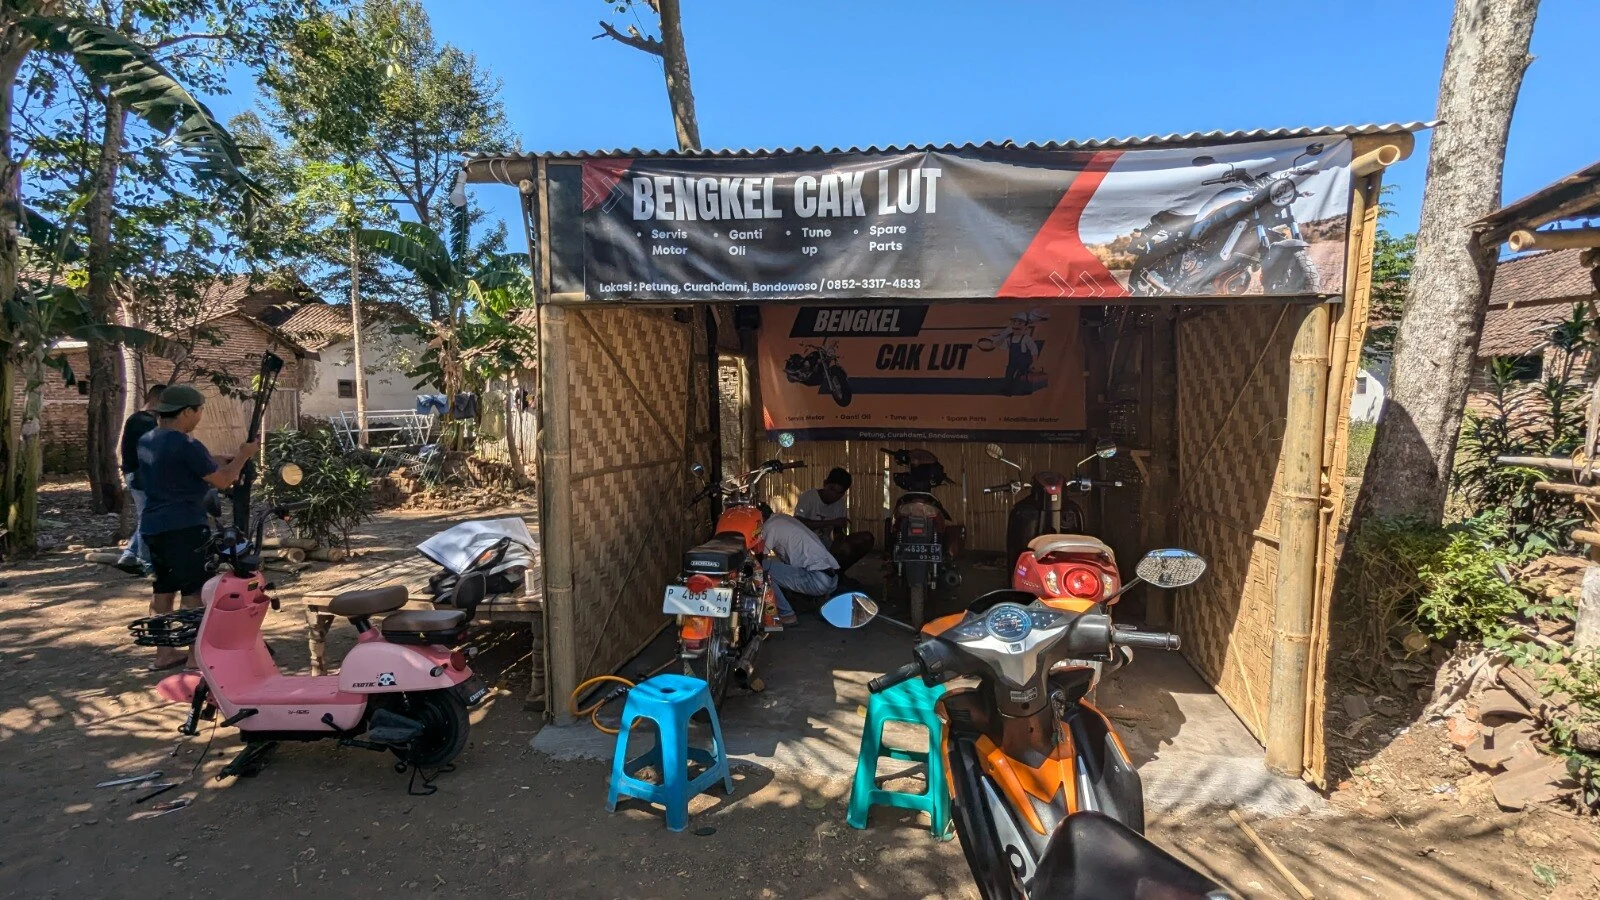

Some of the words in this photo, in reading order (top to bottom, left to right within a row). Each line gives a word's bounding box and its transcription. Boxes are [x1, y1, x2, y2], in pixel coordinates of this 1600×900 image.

[632, 176, 783, 221] BENGKEL
[794, 172, 866, 218] CAK
[878, 168, 942, 216] LUT
[651, 229, 688, 239] Servis
[729, 229, 763, 240] Ganti
[802, 227, 832, 238] Tune
[869, 224, 907, 237] Spare
[652, 245, 688, 256] Motor
[728, 245, 746, 256] Oli
[802, 246, 818, 257] up
[869, 241, 903, 251] Parts
[639, 283, 682, 295] Petung,
[684, 282, 750, 293] Curahdami,
[752, 282, 818, 292] Bondowoso
[826, 279, 921, 290] 0852-3317-4833
[813, 308, 900, 332] BENGKEL
[875, 343, 925, 371] CAK
[927, 344, 972, 371] LUT
[668, 589, 674, 598] P
